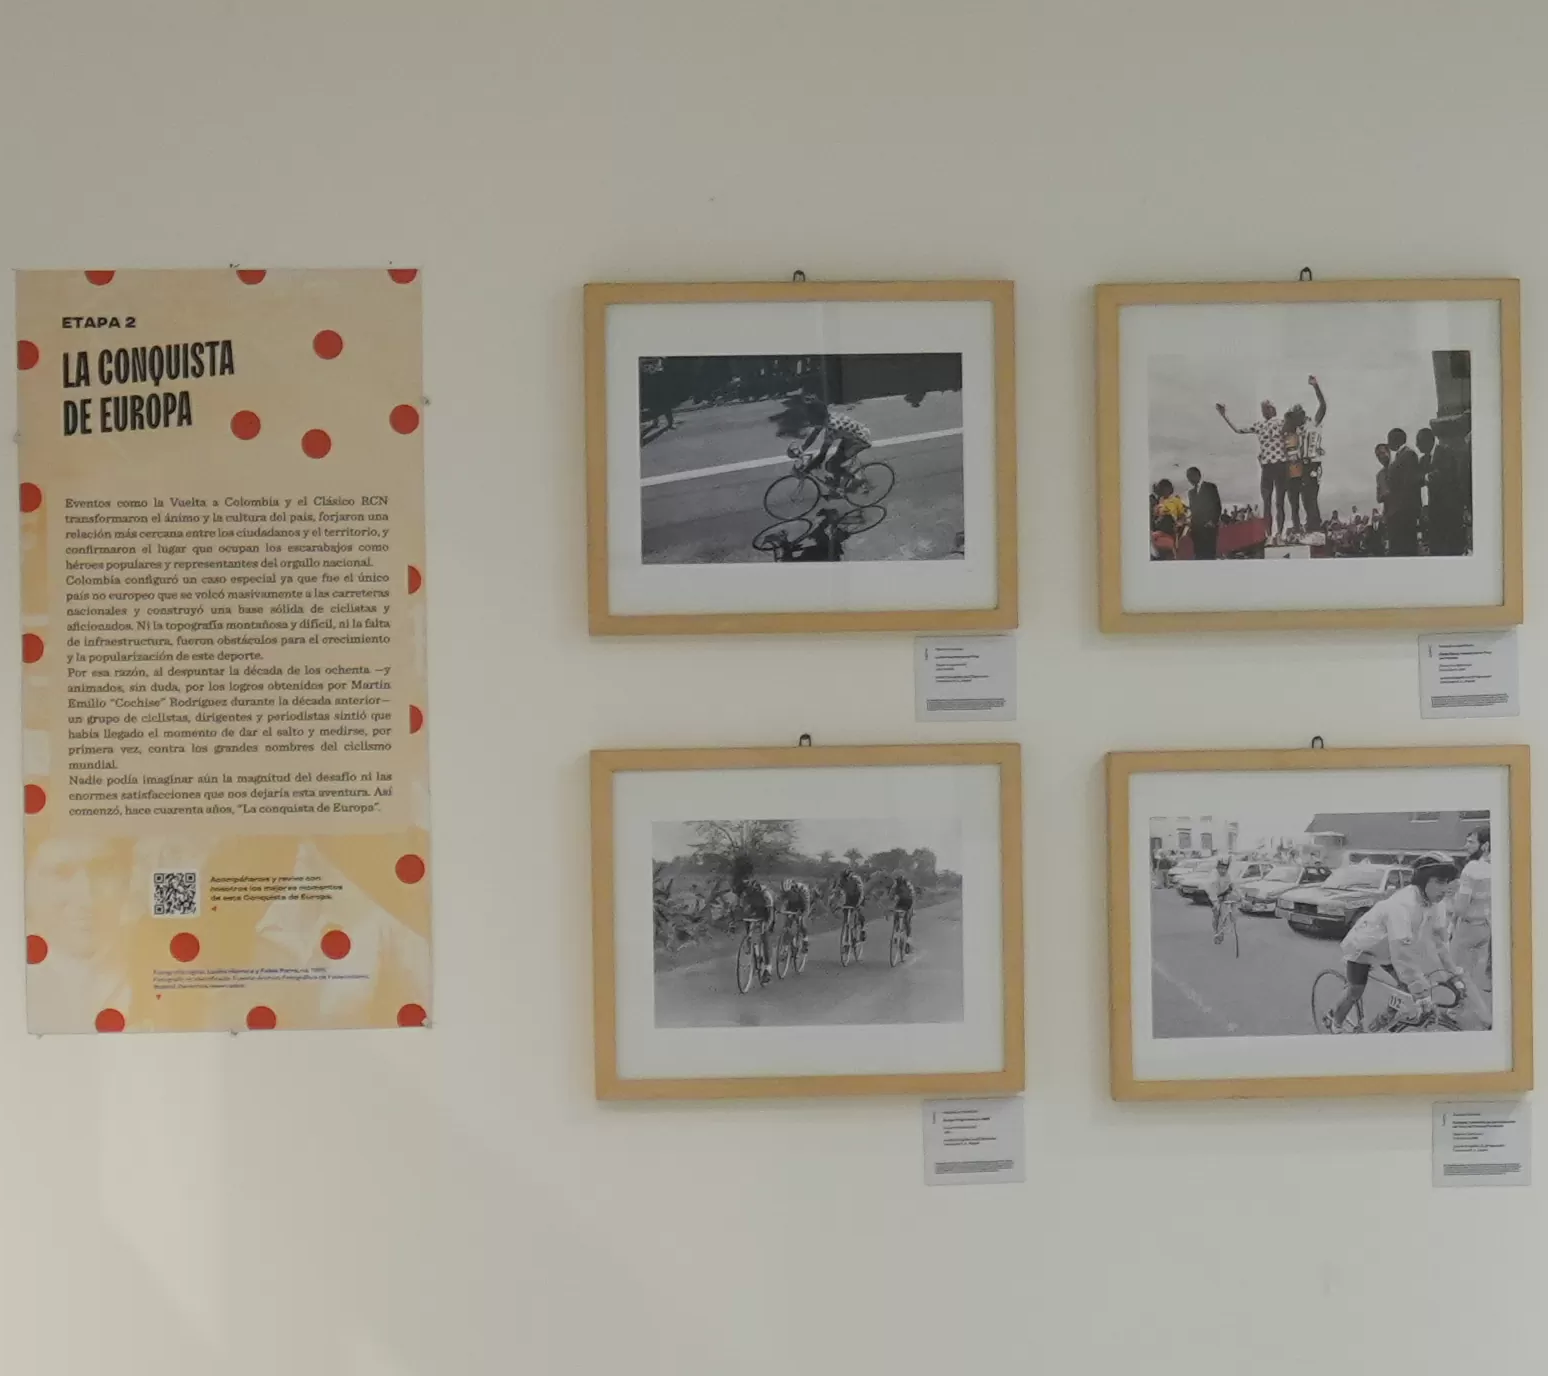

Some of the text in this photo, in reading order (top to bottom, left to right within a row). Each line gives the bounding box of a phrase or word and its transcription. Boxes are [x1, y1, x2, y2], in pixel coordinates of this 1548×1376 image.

[62, 317, 136, 329] ETAPA 2
[62, 340, 234, 388] LA CONQUISTA
[63, 390, 192, 436] DE EUROPA
[65, 495, 389, 509] Eventos como la Vuelta a Colombia y el Clásico RCN
[65, 542, 390, 556] confirmaron el lugar que ocupan los escarabajos como
[65, 572, 390, 587] Colombia configuró un caso especial ya que fue el único
[66, 603, 391, 618] nacionales y construyó una base sólida de ciclistas y
[67, 679, 392, 694] animados, sin duda, por los logros obtenidos por Martín
[68, 759, 120, 770] mundial.
